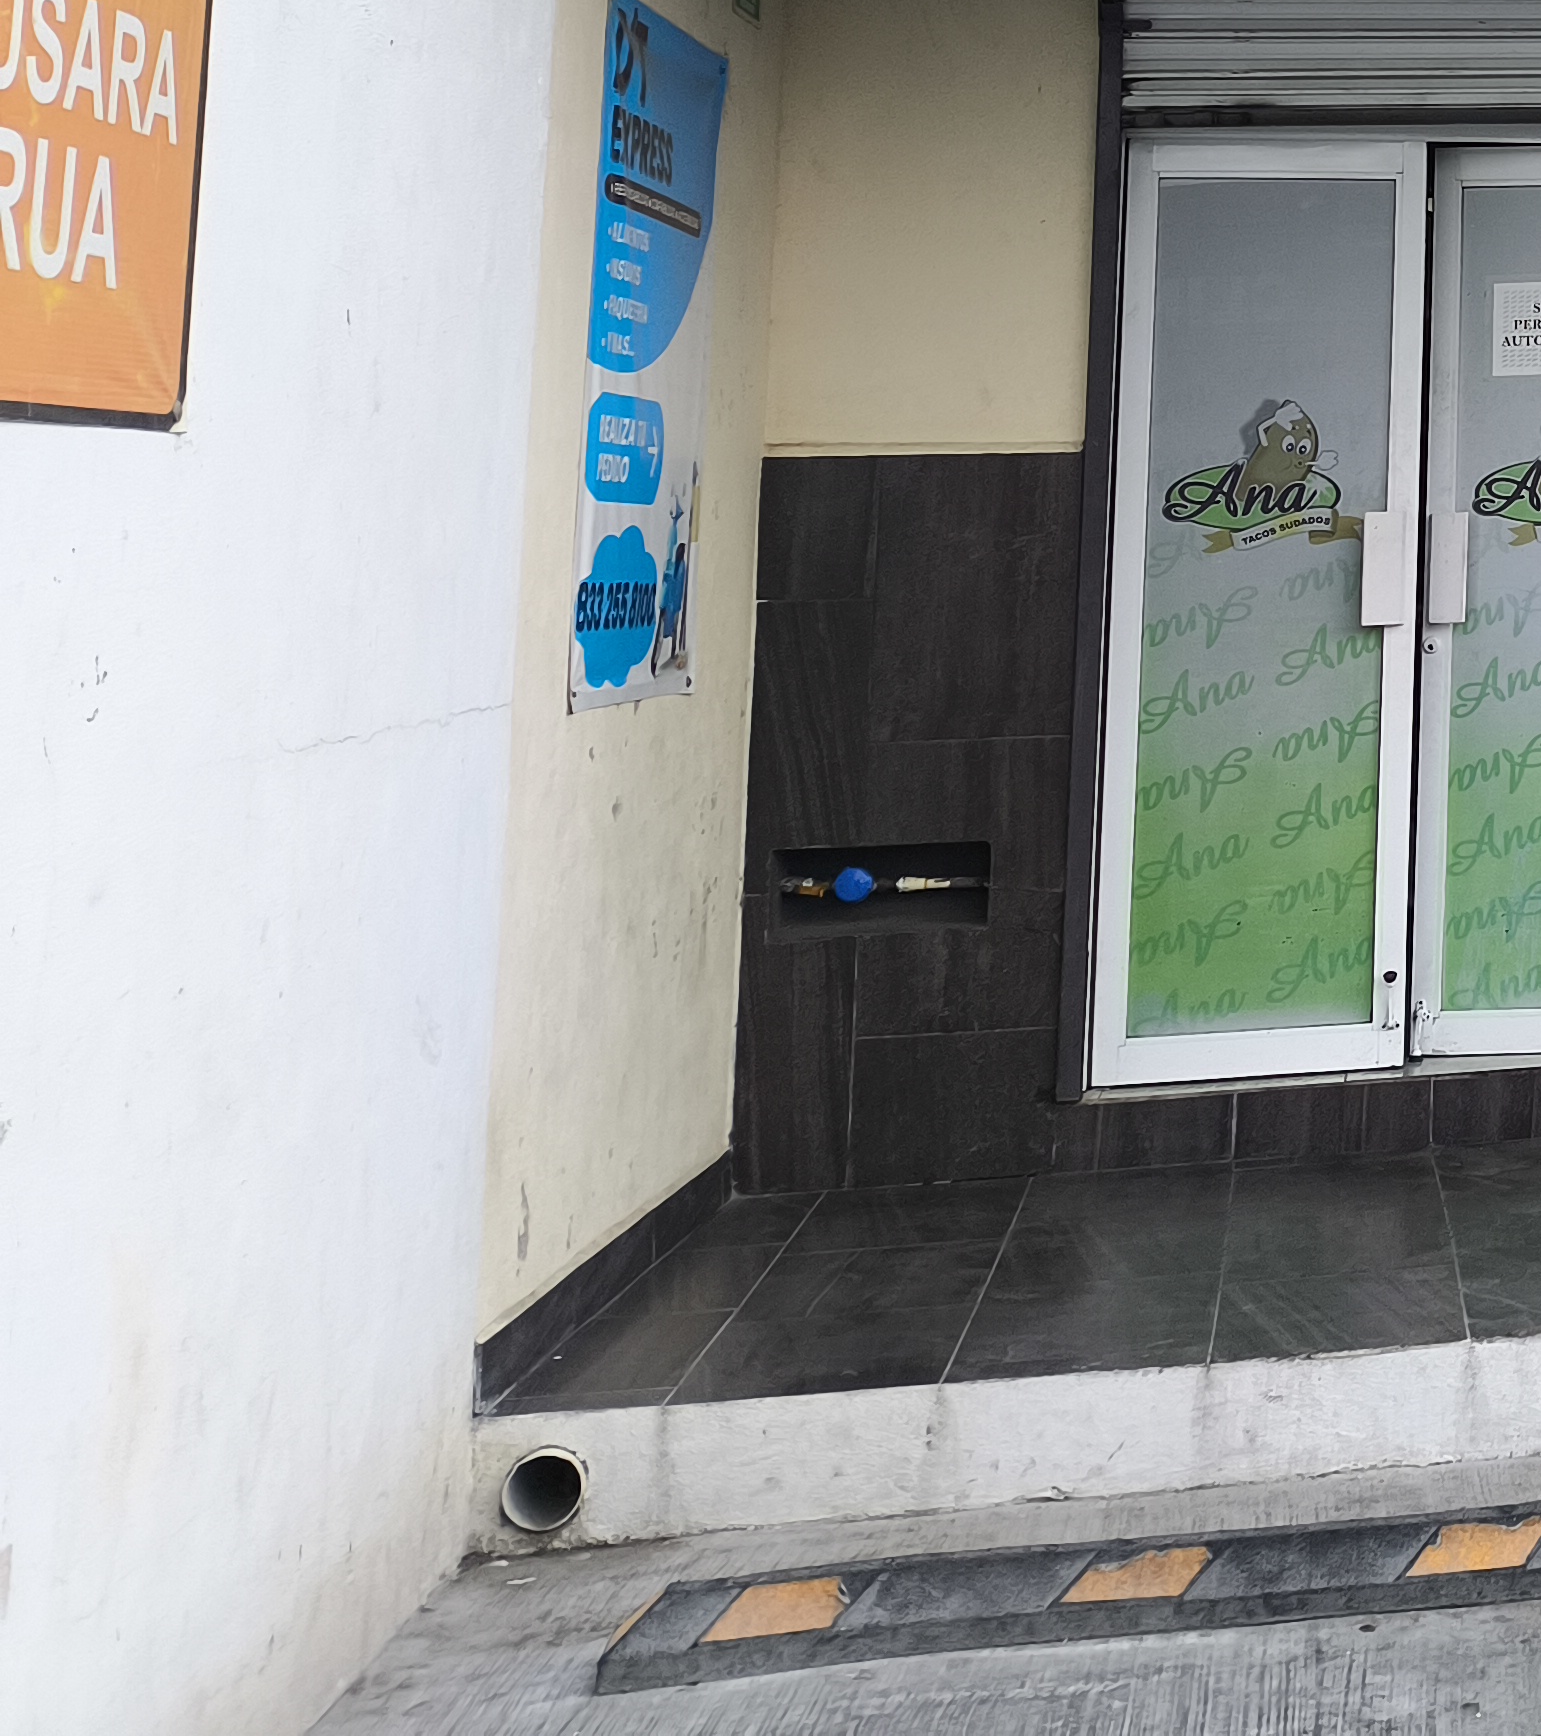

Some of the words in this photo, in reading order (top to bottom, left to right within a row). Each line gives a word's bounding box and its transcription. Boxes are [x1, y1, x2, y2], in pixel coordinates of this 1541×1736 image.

[611, 105, 673, 187] EXPRESS
[1162, 458, 1320, 522] Ana
[1241, 527, 1277, 546] TACOS
[1278, 515, 1331, 536] SUDADOS
[603, 581, 630, 630] 255
